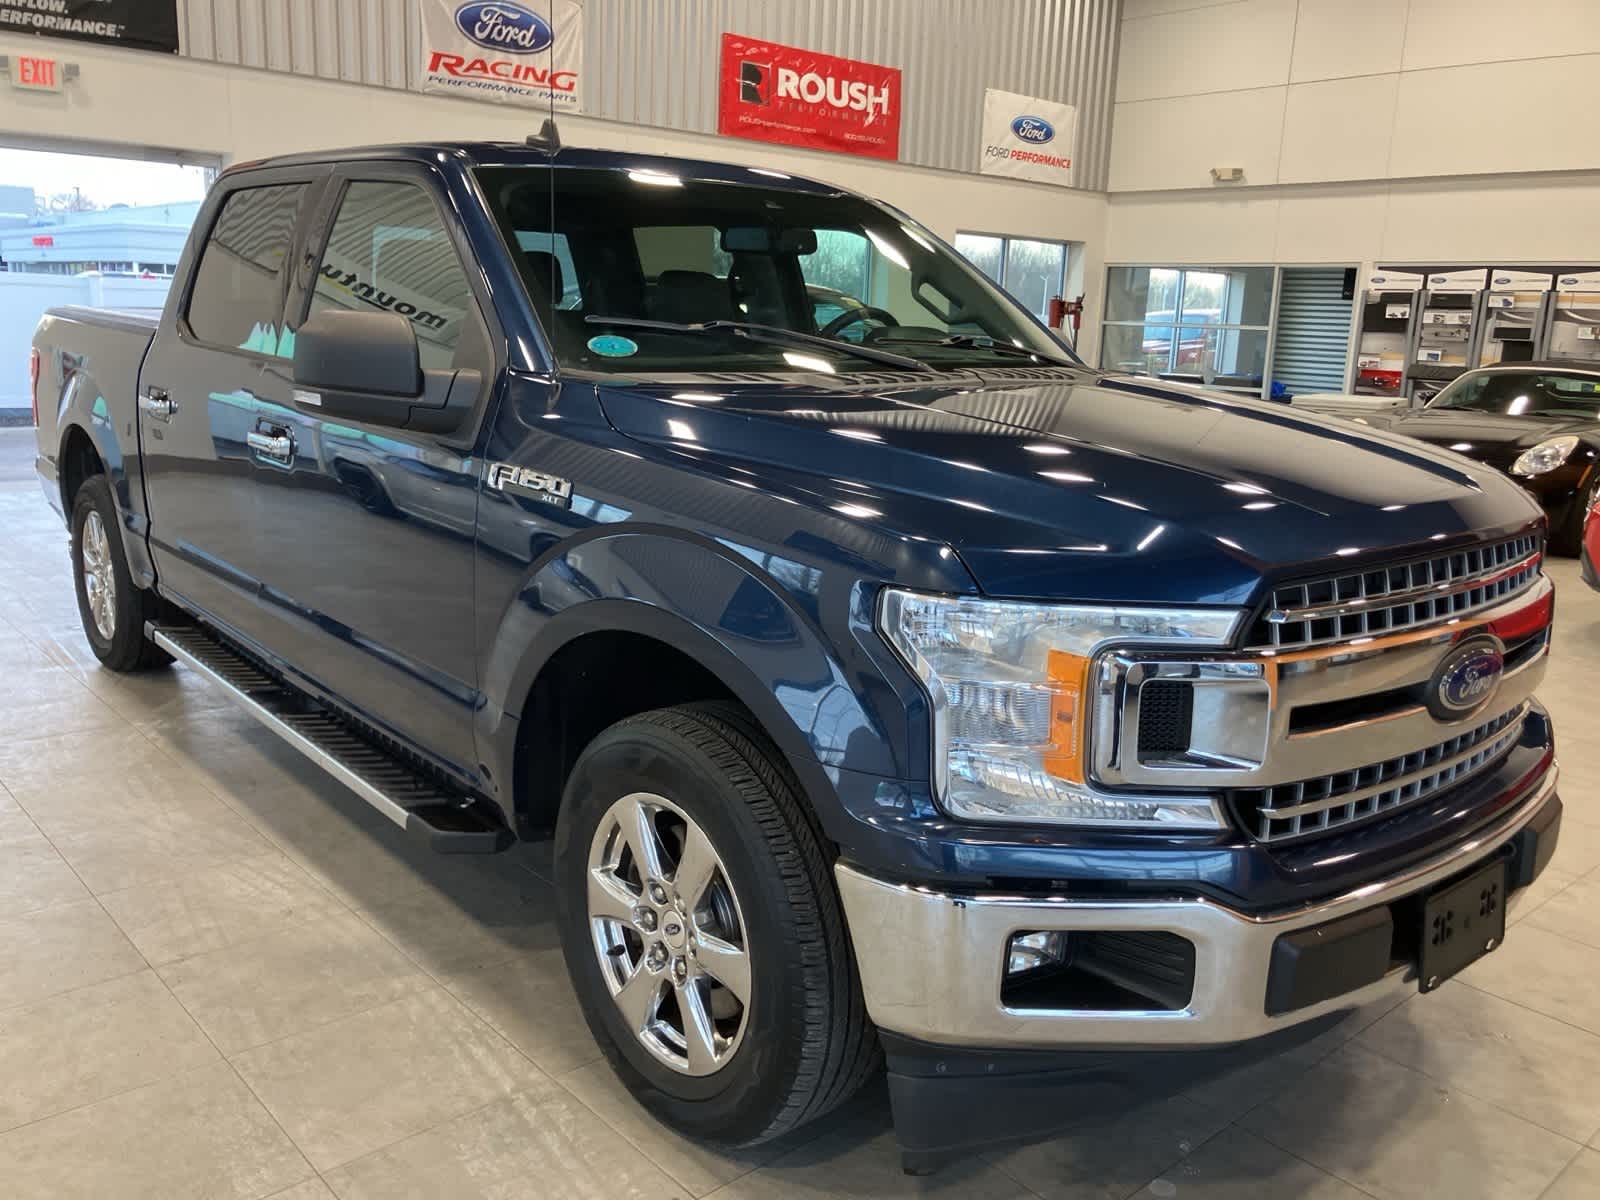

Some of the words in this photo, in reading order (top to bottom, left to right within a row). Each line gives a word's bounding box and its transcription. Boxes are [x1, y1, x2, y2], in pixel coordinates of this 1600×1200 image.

[474, 6, 536, 47] Ford
[19, 56, 56, 87] EXIT
[428, 51, 578, 92] RACING
[428, 75, 535, 96] PERFORMANCE
[539, 91, 577, 102] PARTS
[777, 67, 889, 115] ROUSH
[1019, 119, 1046, 140] Ford
[985, 145, 1010, 159] FORD
[1010, 150, 1071, 169] PERFORMANCE
[542, 494, 558, 505] XLT
